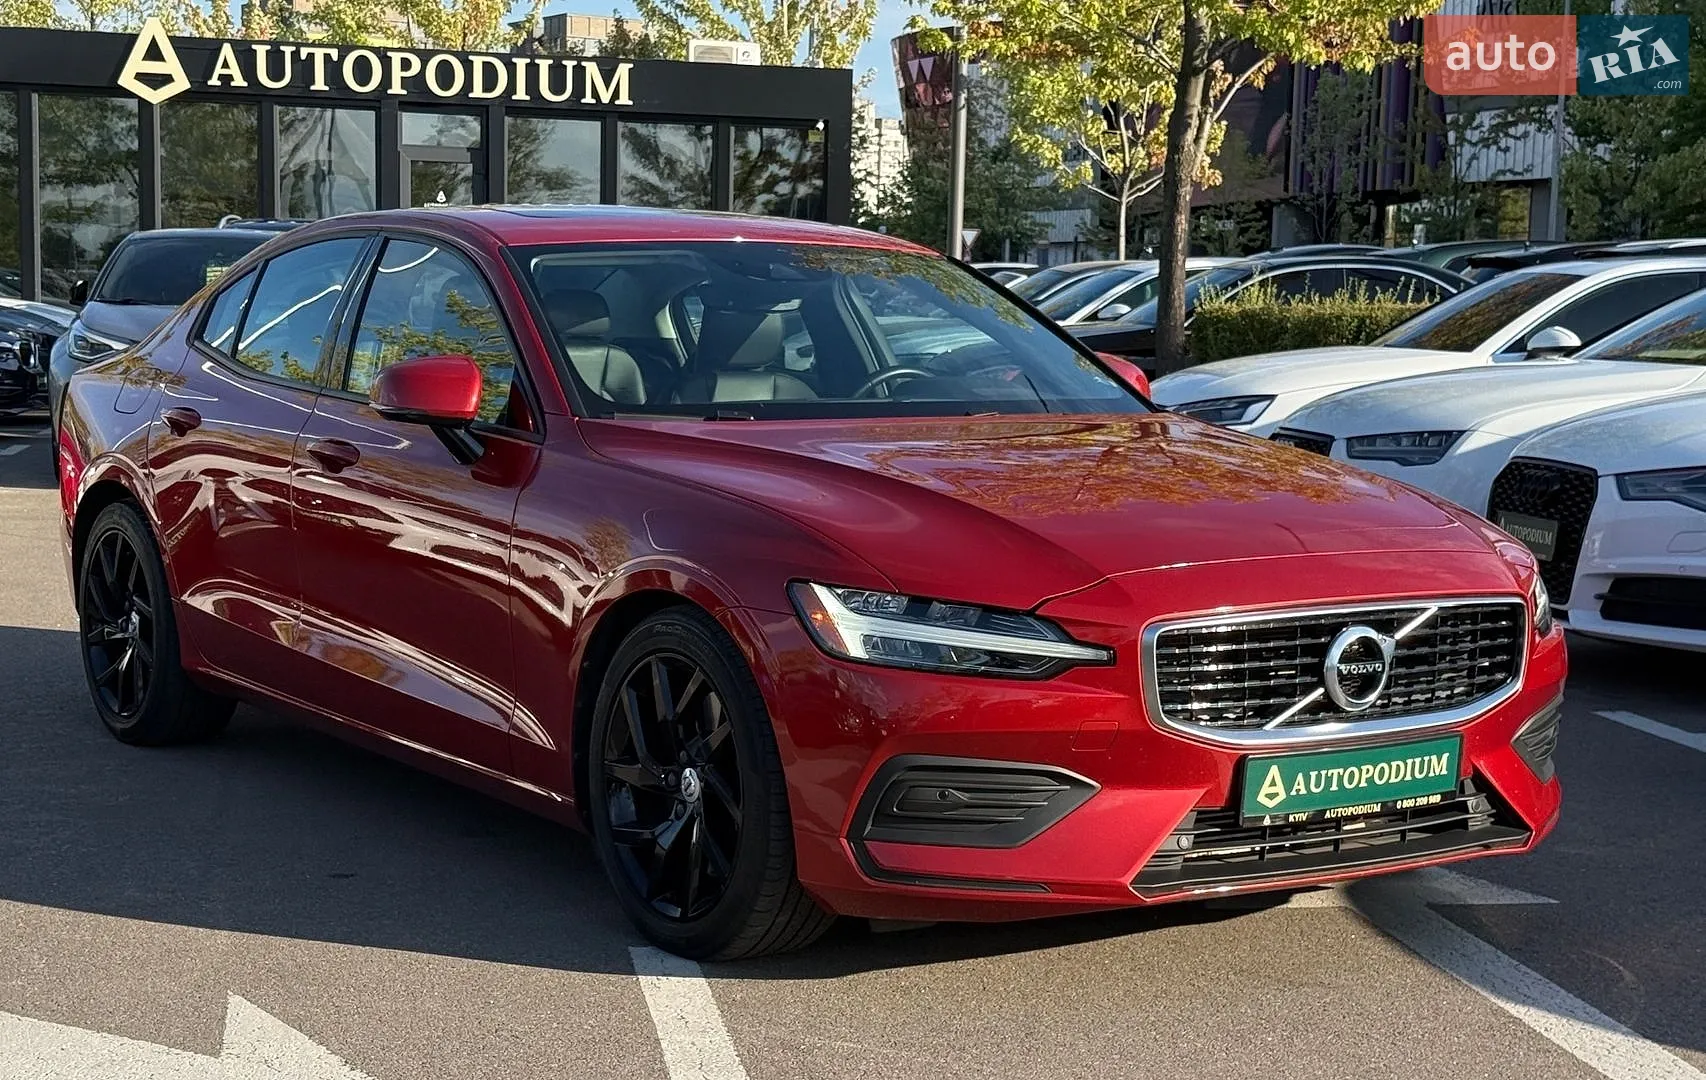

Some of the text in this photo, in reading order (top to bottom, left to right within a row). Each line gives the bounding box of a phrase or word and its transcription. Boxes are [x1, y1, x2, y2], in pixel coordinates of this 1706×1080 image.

[207, 42, 634, 106] AUTOPODIUM
[1340, 663, 1383, 675] VOLVO
[1290, 752, 1450, 796] AUTOPODIUM
[1288, 812, 1309, 823] KYIV
[1324, 803, 1381, 819] AUTOPODIUM
